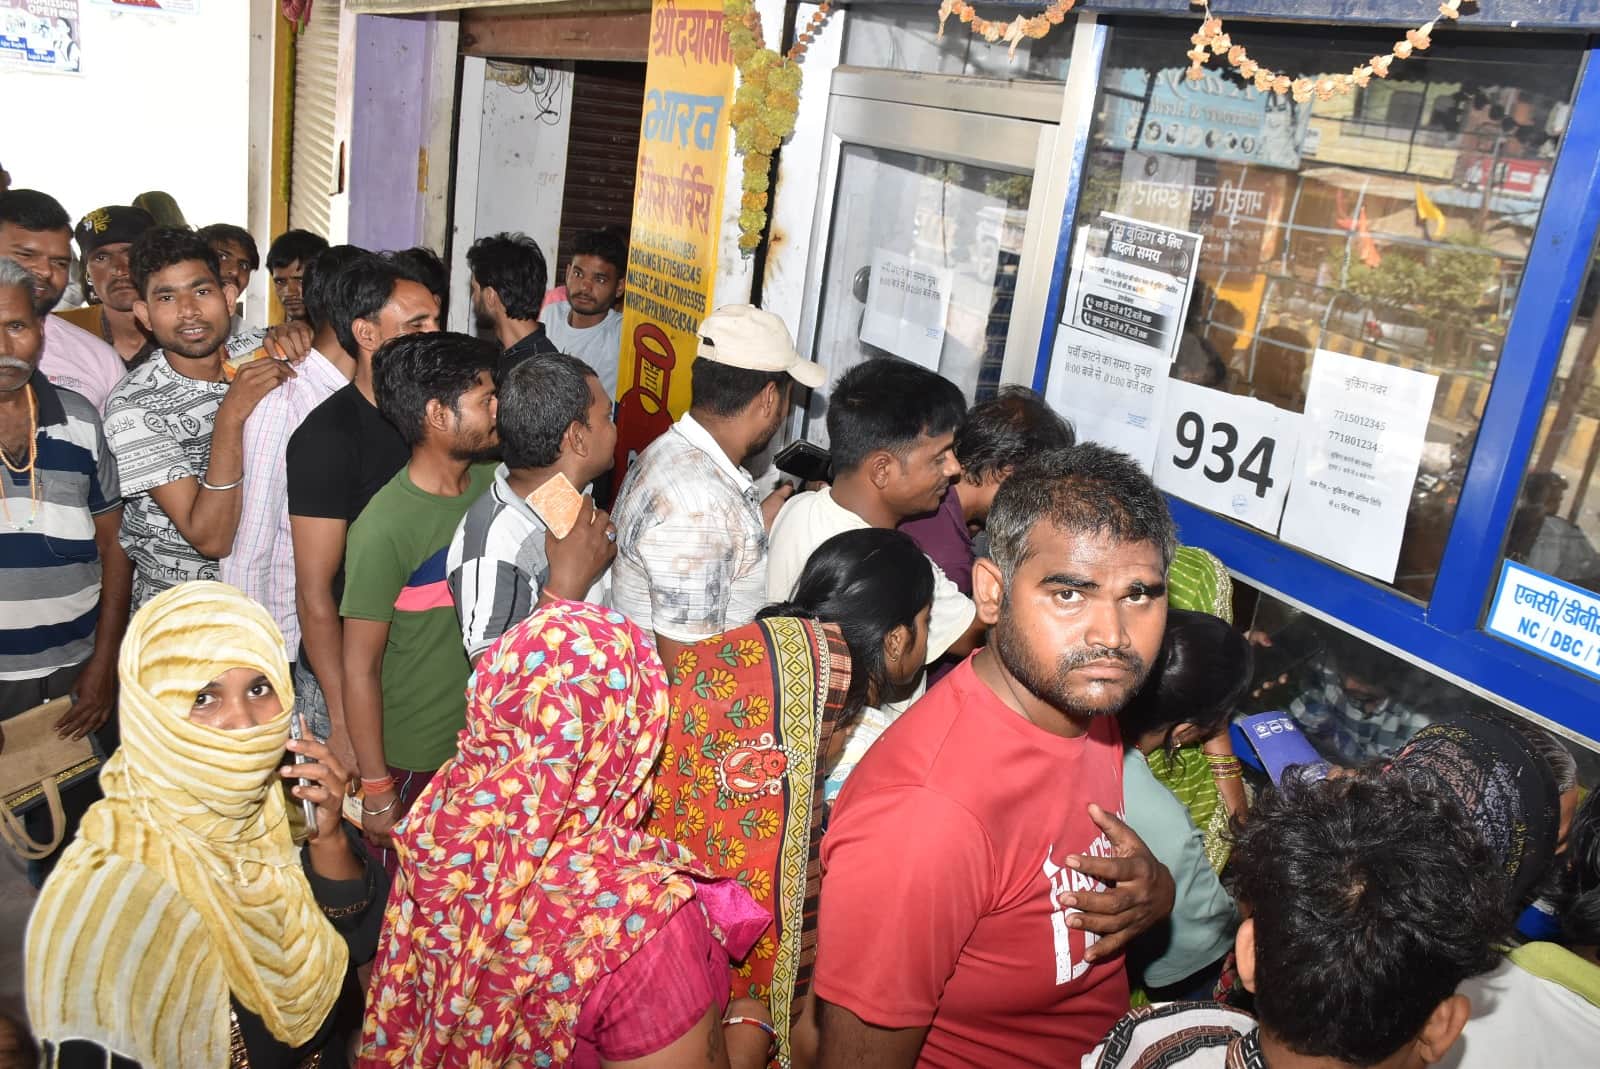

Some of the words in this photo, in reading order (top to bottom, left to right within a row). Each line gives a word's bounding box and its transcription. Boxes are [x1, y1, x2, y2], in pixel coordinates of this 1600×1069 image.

[643, 88, 724, 151] भारत
[1126, 225, 1156, 245] बुकिंग
[1157, 232, 1166, 246] के
[1166, 233, 1183, 249] लिए
[1111, 240, 1135, 257] बदला
[1136, 247, 1162, 263] समय
[1103, 317, 1110, 328] 5
[1124, 306, 1133, 318] 12
[1101, 355, 1113, 367] का
[1134, 363, 1152, 378] सुबह
[1140, 382, 1155, 394] तक
[1333, 408, 1387, 431] 7715012345
[1172, 411, 1276, 498] 934
[1514, 583, 1600, 636] एनसी/डीबी
